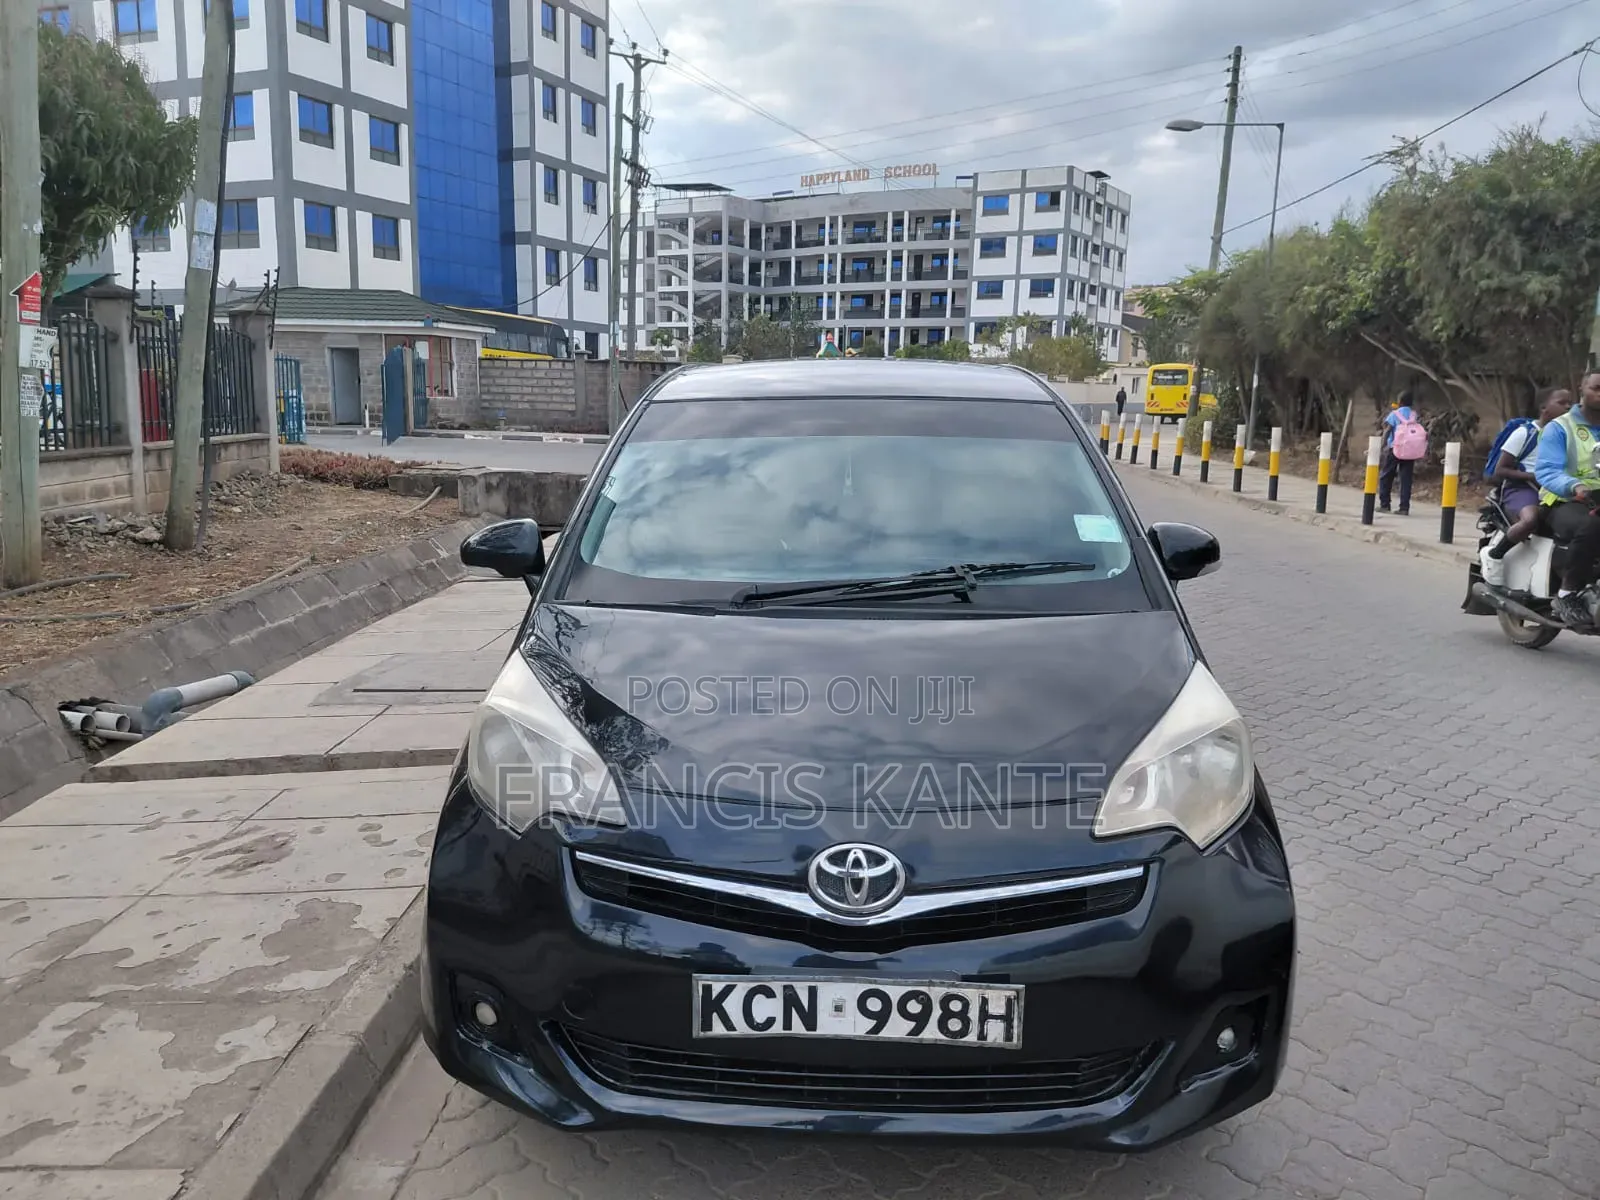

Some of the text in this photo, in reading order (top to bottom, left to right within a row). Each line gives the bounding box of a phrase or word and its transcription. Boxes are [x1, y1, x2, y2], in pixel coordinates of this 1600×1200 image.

[800, 163, 940, 187] HAPPYLAND SCHOOL
[700, 983, 1018, 1042] KCN 998H
